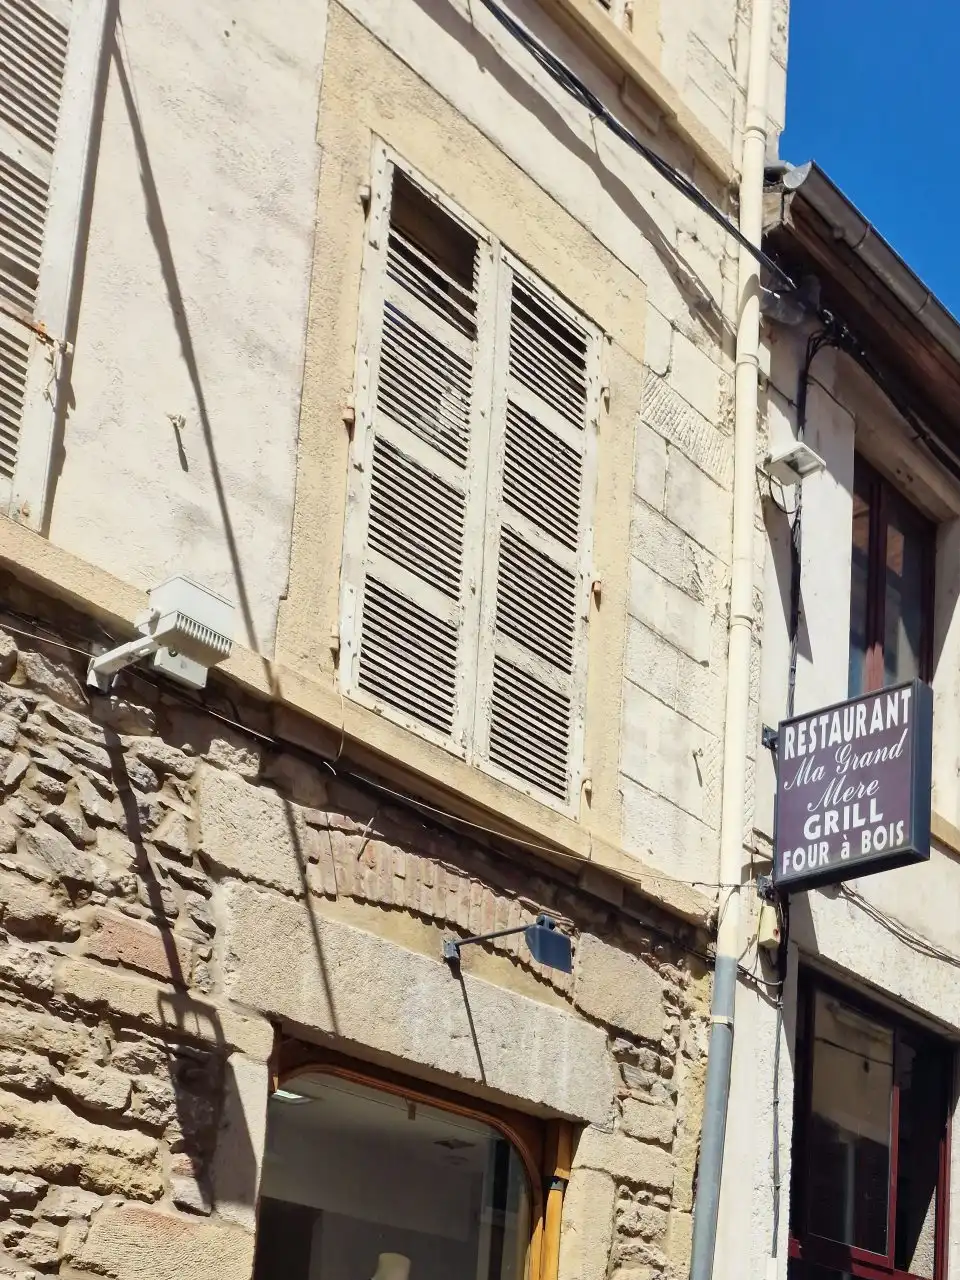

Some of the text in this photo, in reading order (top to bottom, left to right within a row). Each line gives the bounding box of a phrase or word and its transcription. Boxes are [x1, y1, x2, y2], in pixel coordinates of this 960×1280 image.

[784, 688, 912, 760] RESTAURANT
[783, 728, 908, 790] Ma Grand
[803, 798, 883, 840] GRILL
[807, 775, 880, 812] Mere
[782, 820, 904, 875] FOUR à BOIS
